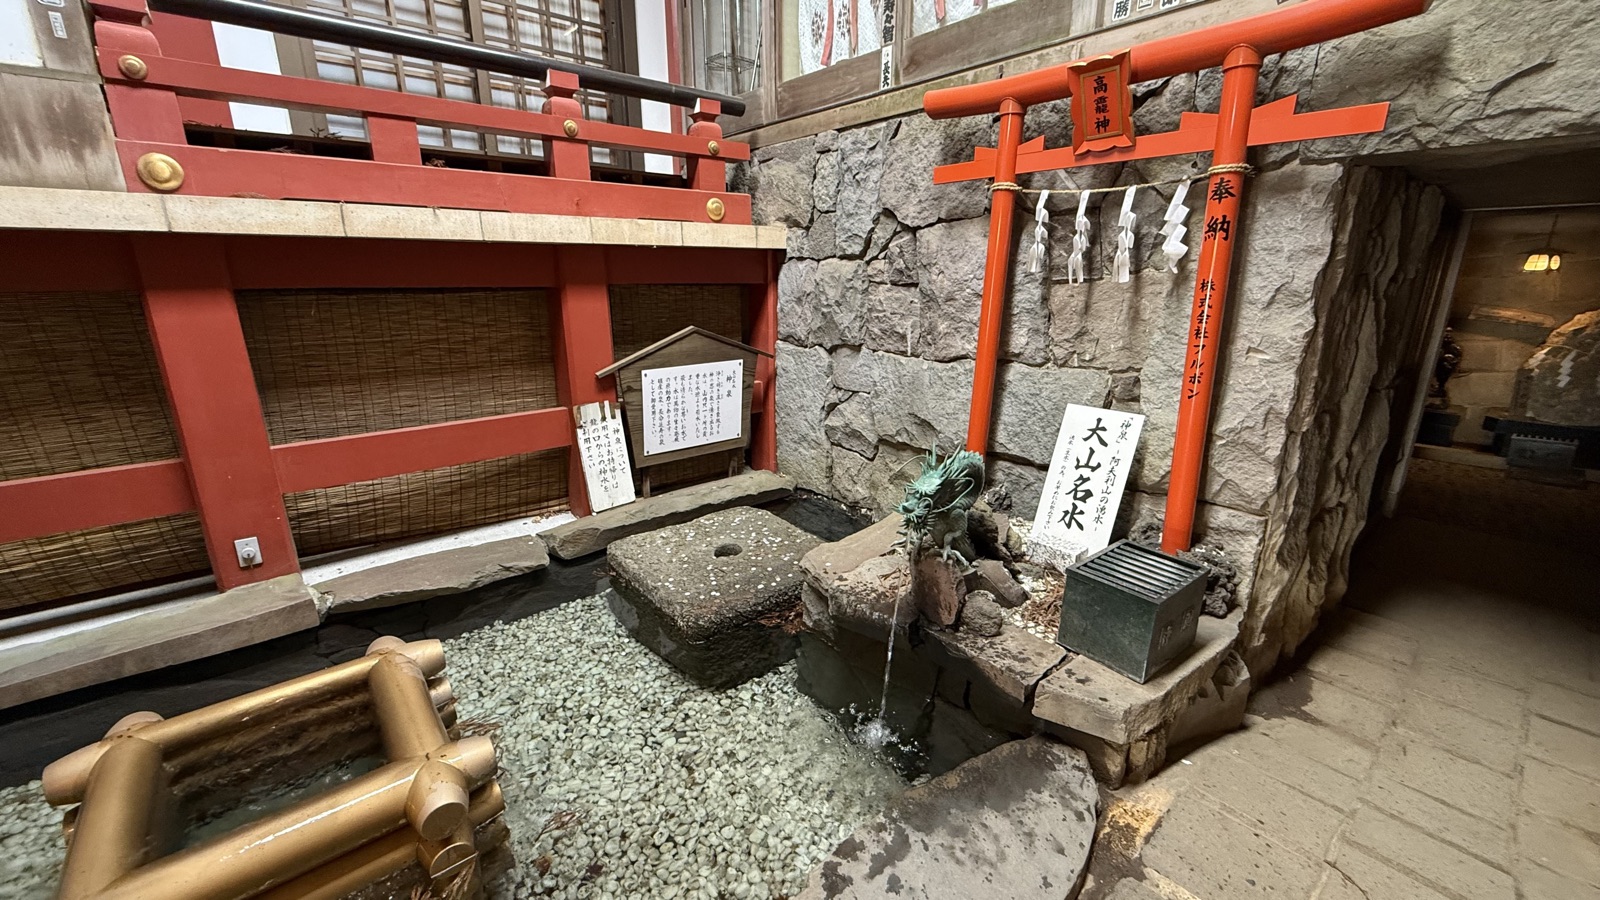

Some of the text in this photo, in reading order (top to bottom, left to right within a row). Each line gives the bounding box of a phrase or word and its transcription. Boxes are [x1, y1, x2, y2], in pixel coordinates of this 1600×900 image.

[1205, 178, 1236, 242] 奉納
[725, 373, 733, 398] 神泉
[1058, 417, 1108, 531] 大山名水
